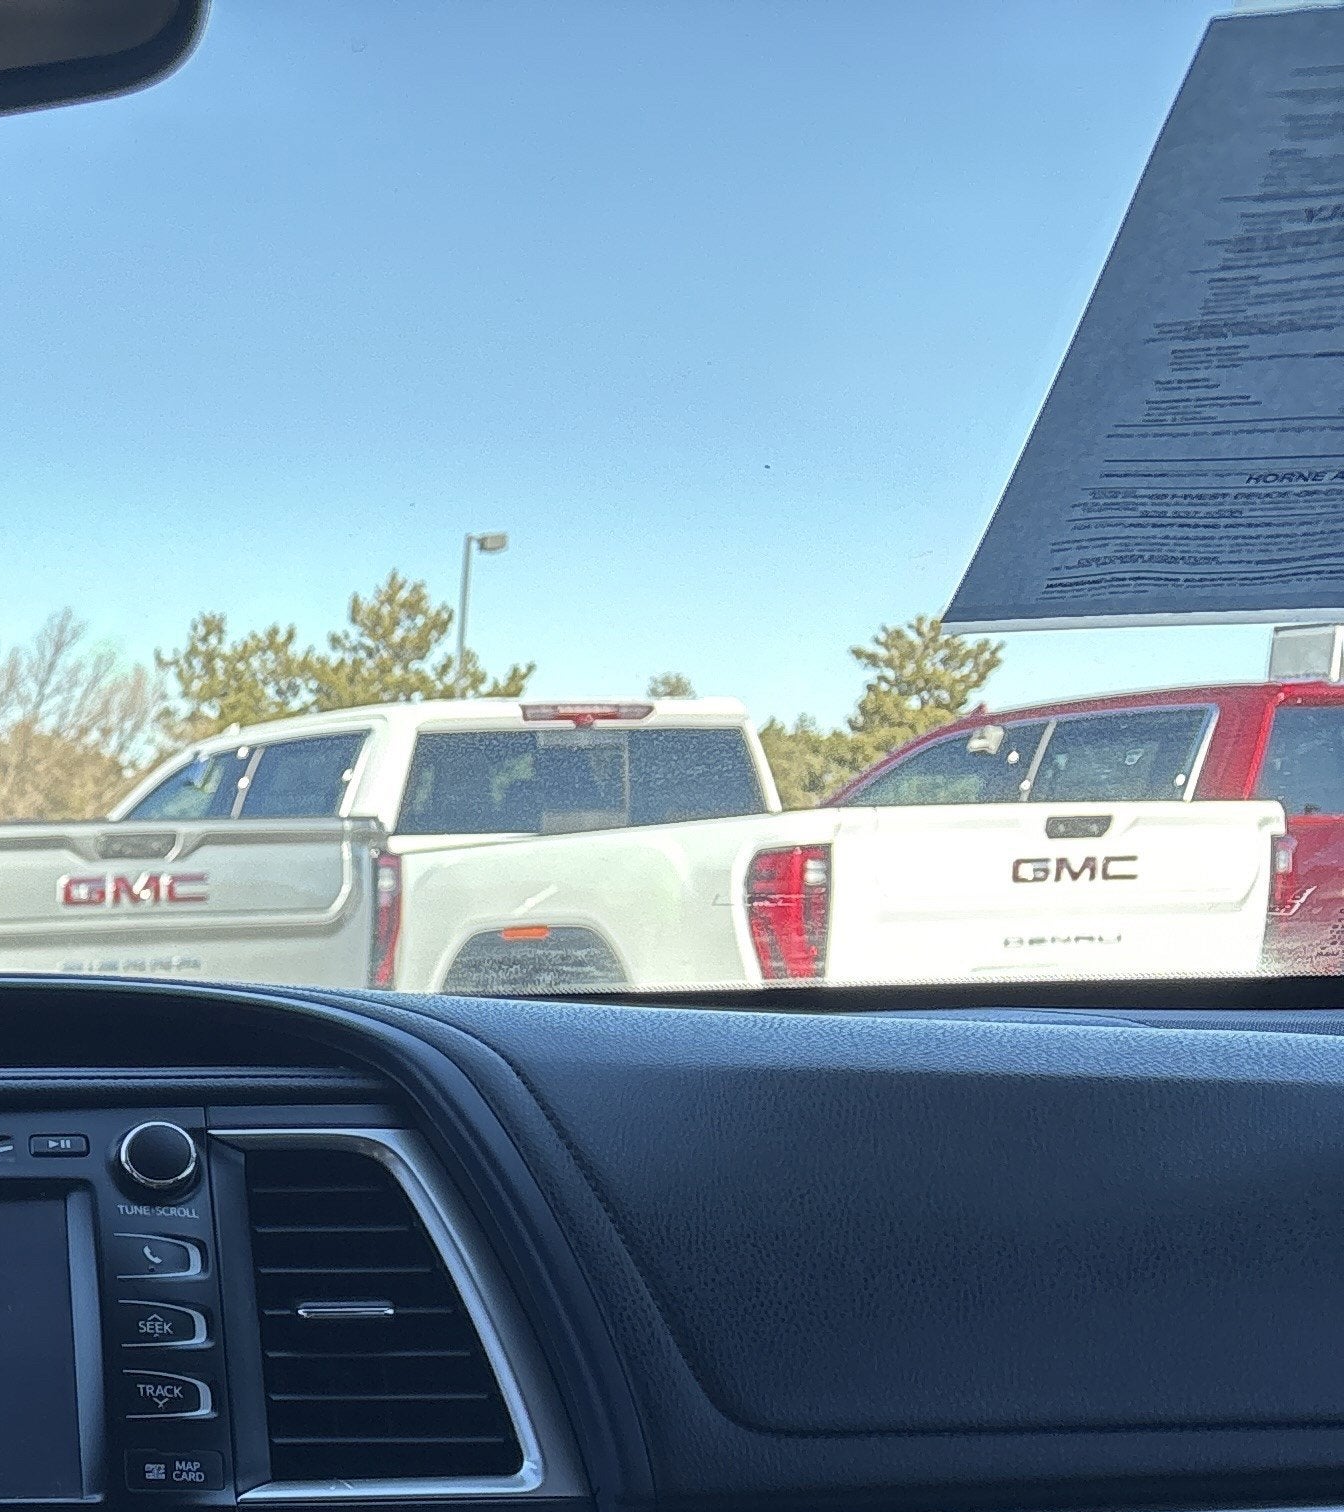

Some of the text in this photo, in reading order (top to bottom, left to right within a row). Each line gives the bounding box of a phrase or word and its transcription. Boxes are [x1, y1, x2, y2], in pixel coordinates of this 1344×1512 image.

[1012, 855, 1138, 883] GMC
[59, 872, 208, 905] GMC
[138, 1320, 174, 1334] SEEK
[137, 1383, 184, 1399] TRACK
[175, 1460, 201, 1471] MAP
[172, 1471, 205, 1483] CARD
